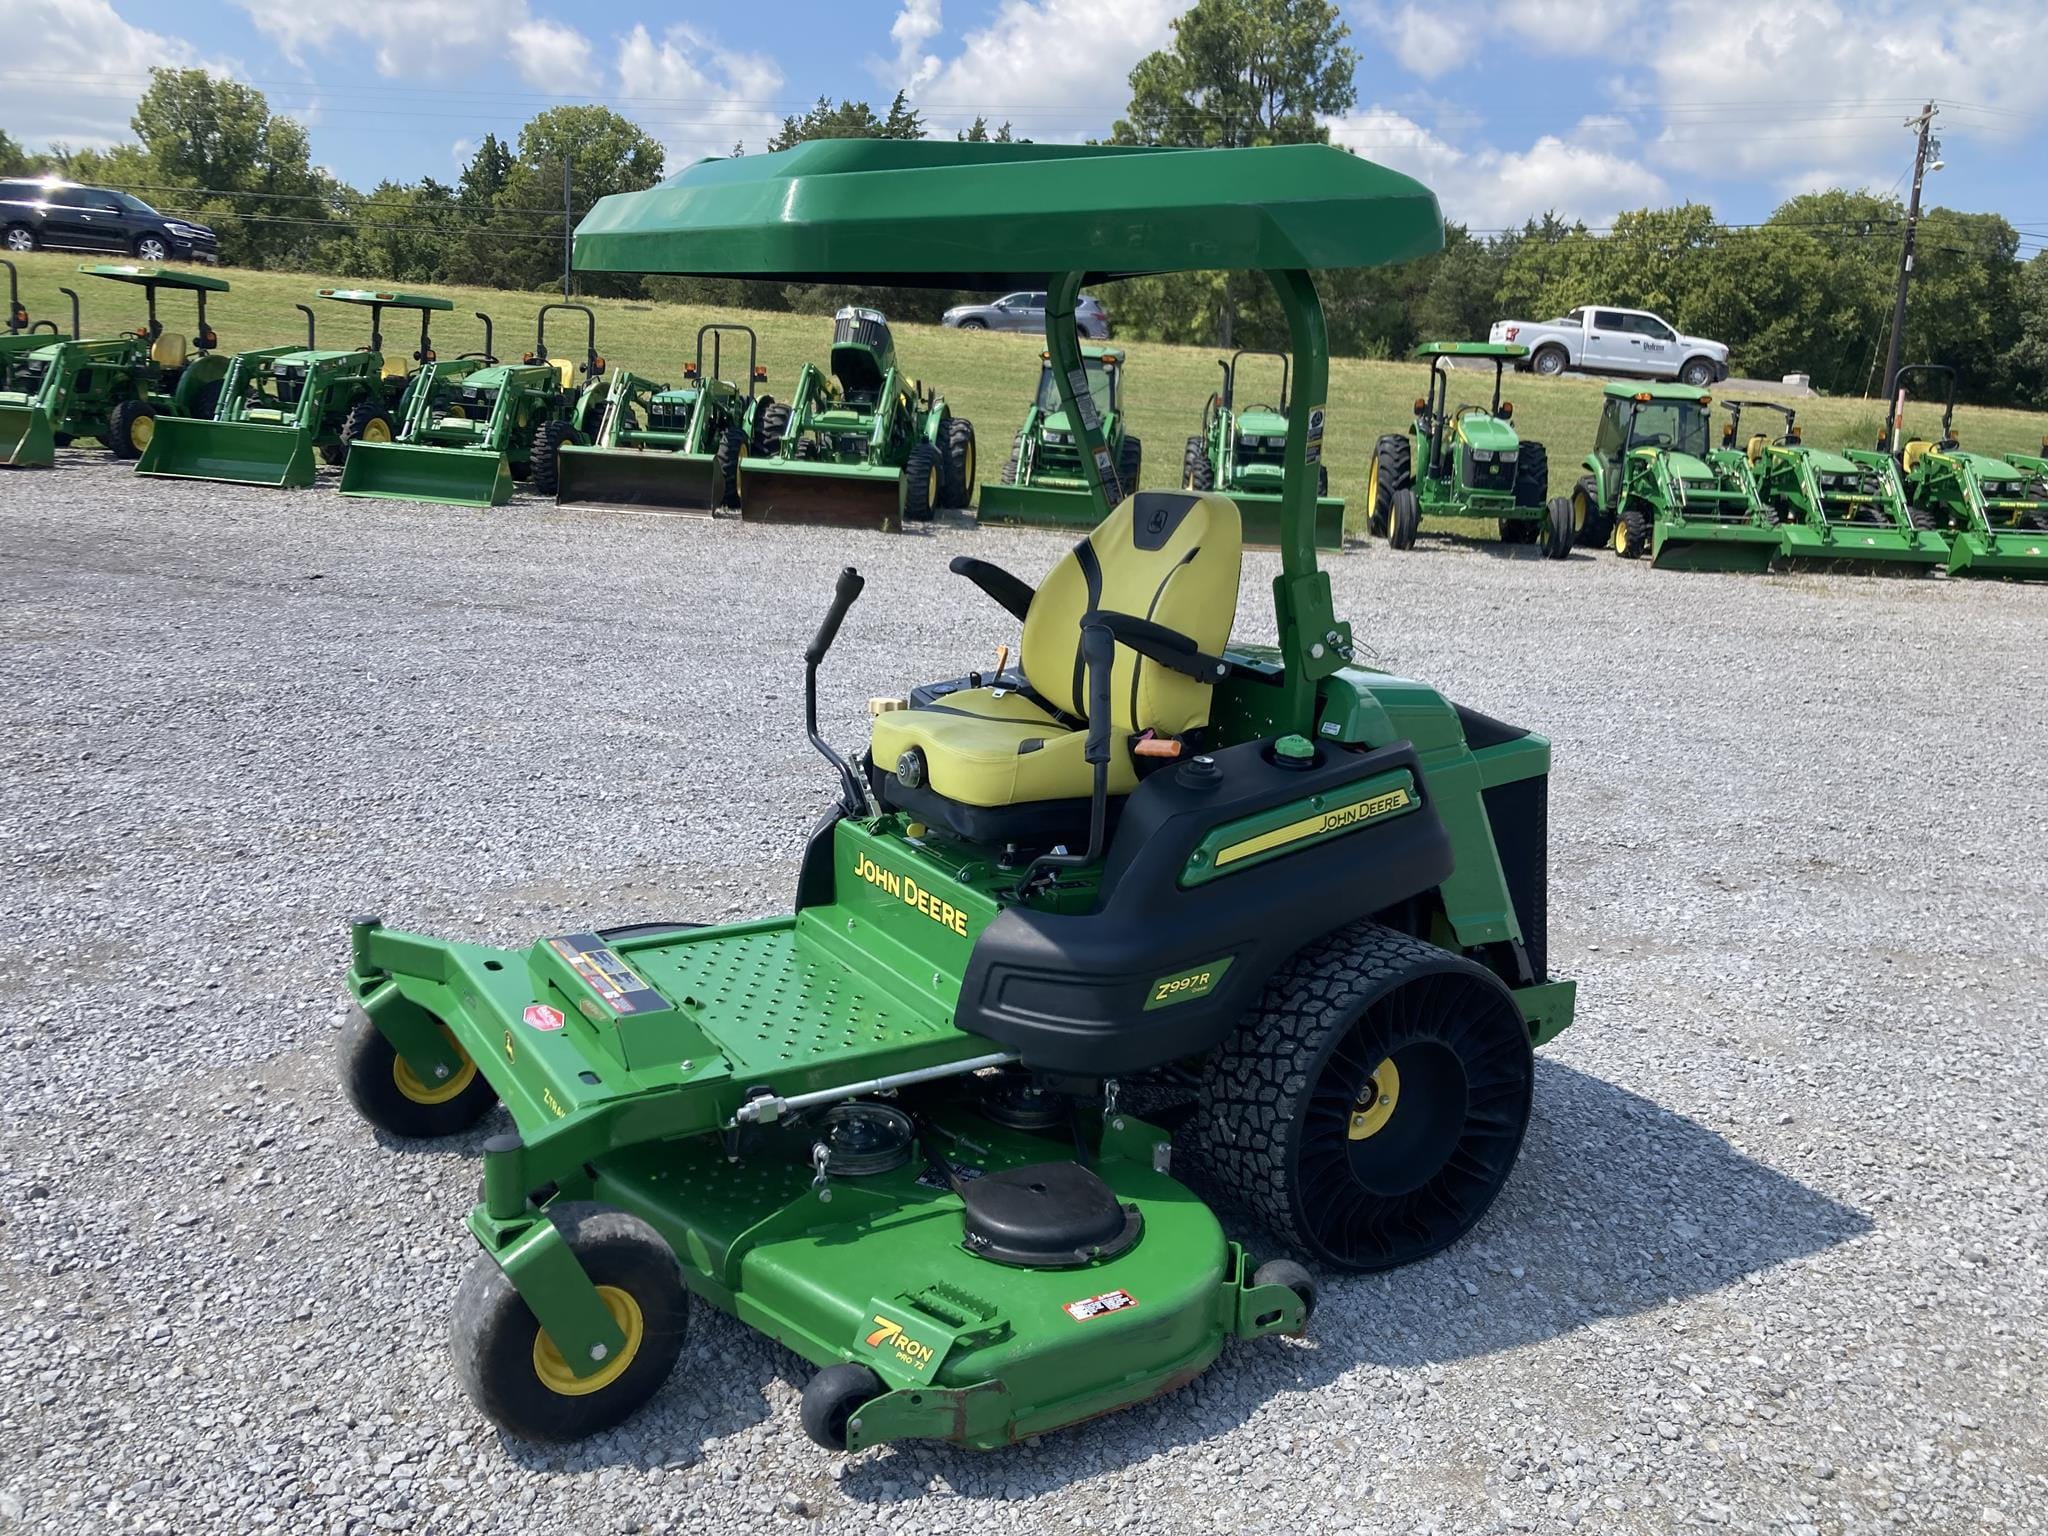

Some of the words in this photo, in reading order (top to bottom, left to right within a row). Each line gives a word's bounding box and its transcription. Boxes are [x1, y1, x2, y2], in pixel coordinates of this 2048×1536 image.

[1319, 808, 1356, 832] JOHN
[1359, 794, 1401, 818] DEERE
[854, 851, 900, 899] JOHN
[903, 875, 968, 938] DEERE
[1155, 972, 1210, 1001] Z997R
[895, 1351, 913, 1365] PRO
[913, 1360, 925, 1371] 72
